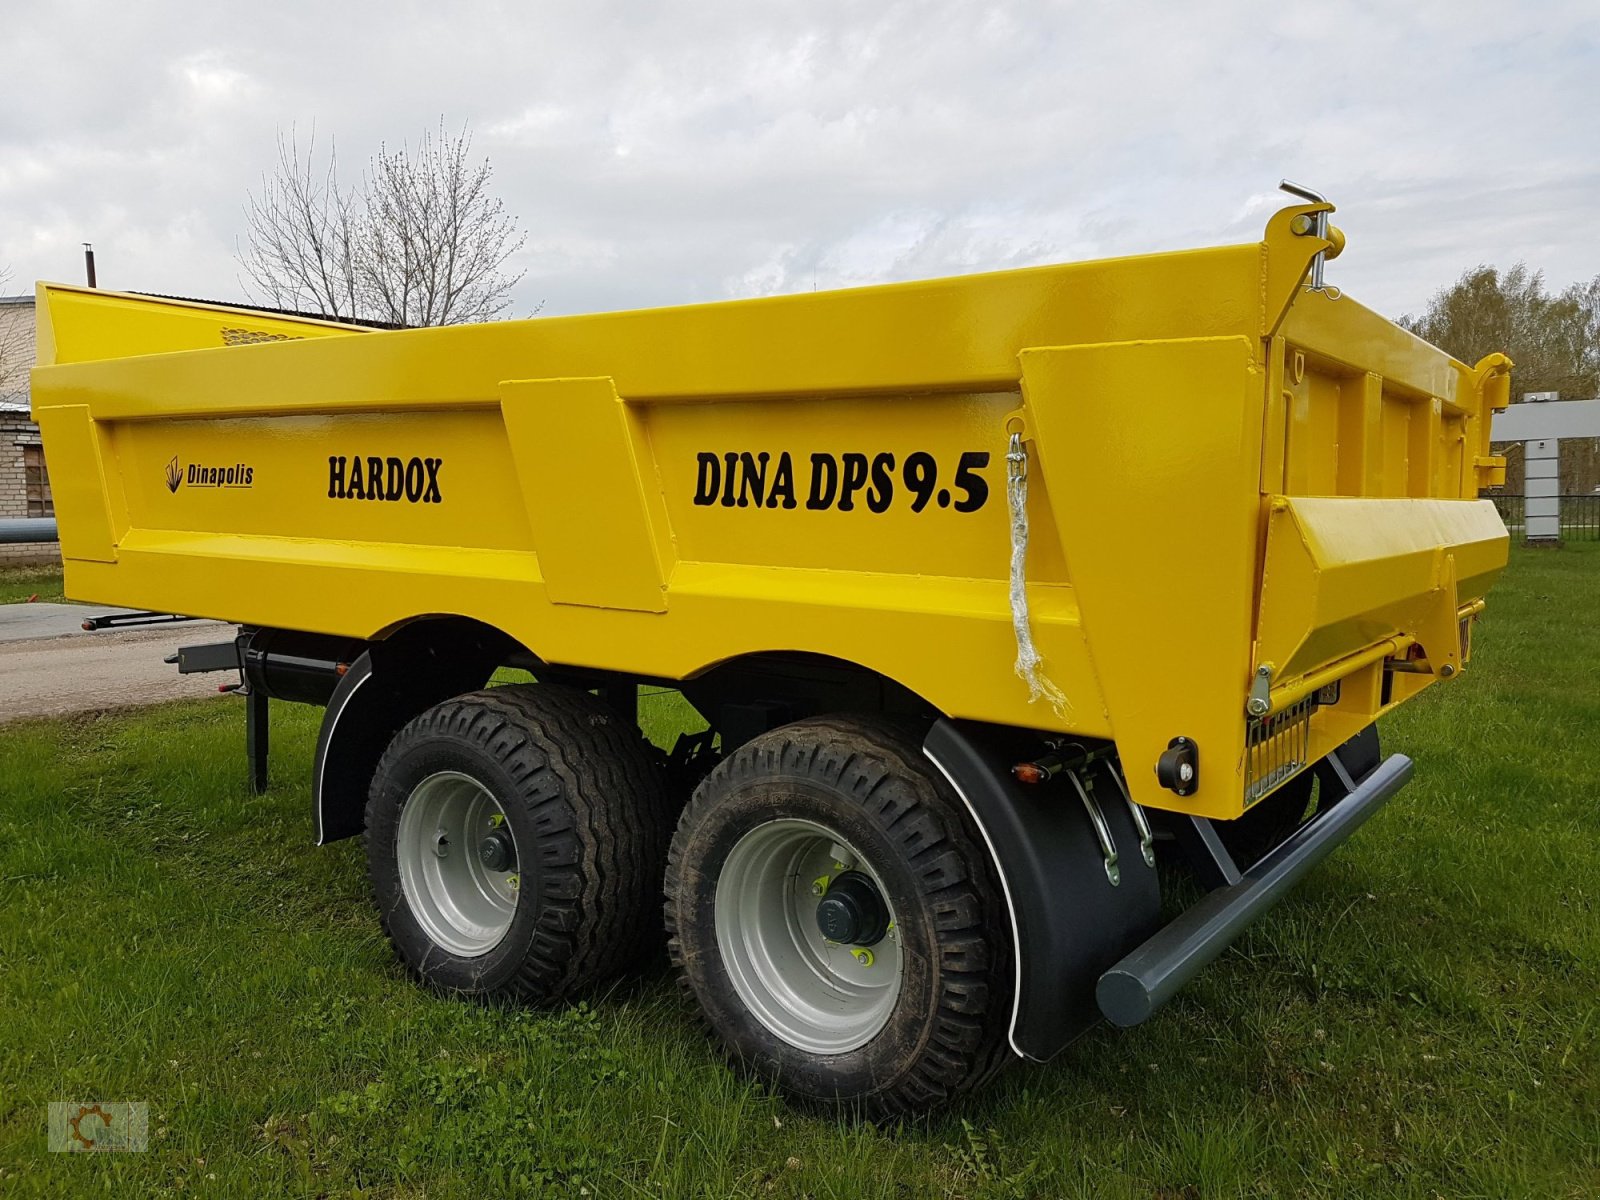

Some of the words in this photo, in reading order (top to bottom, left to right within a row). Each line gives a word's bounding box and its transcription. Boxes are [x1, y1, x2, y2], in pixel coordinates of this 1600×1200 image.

[186, 463, 254, 487] Dinapolis
[327, 455, 442, 503] HARDOX
[693, 451, 798, 509] DINA
[806, 452, 896, 514] DPS
[902, 451, 990, 514] 9.5
